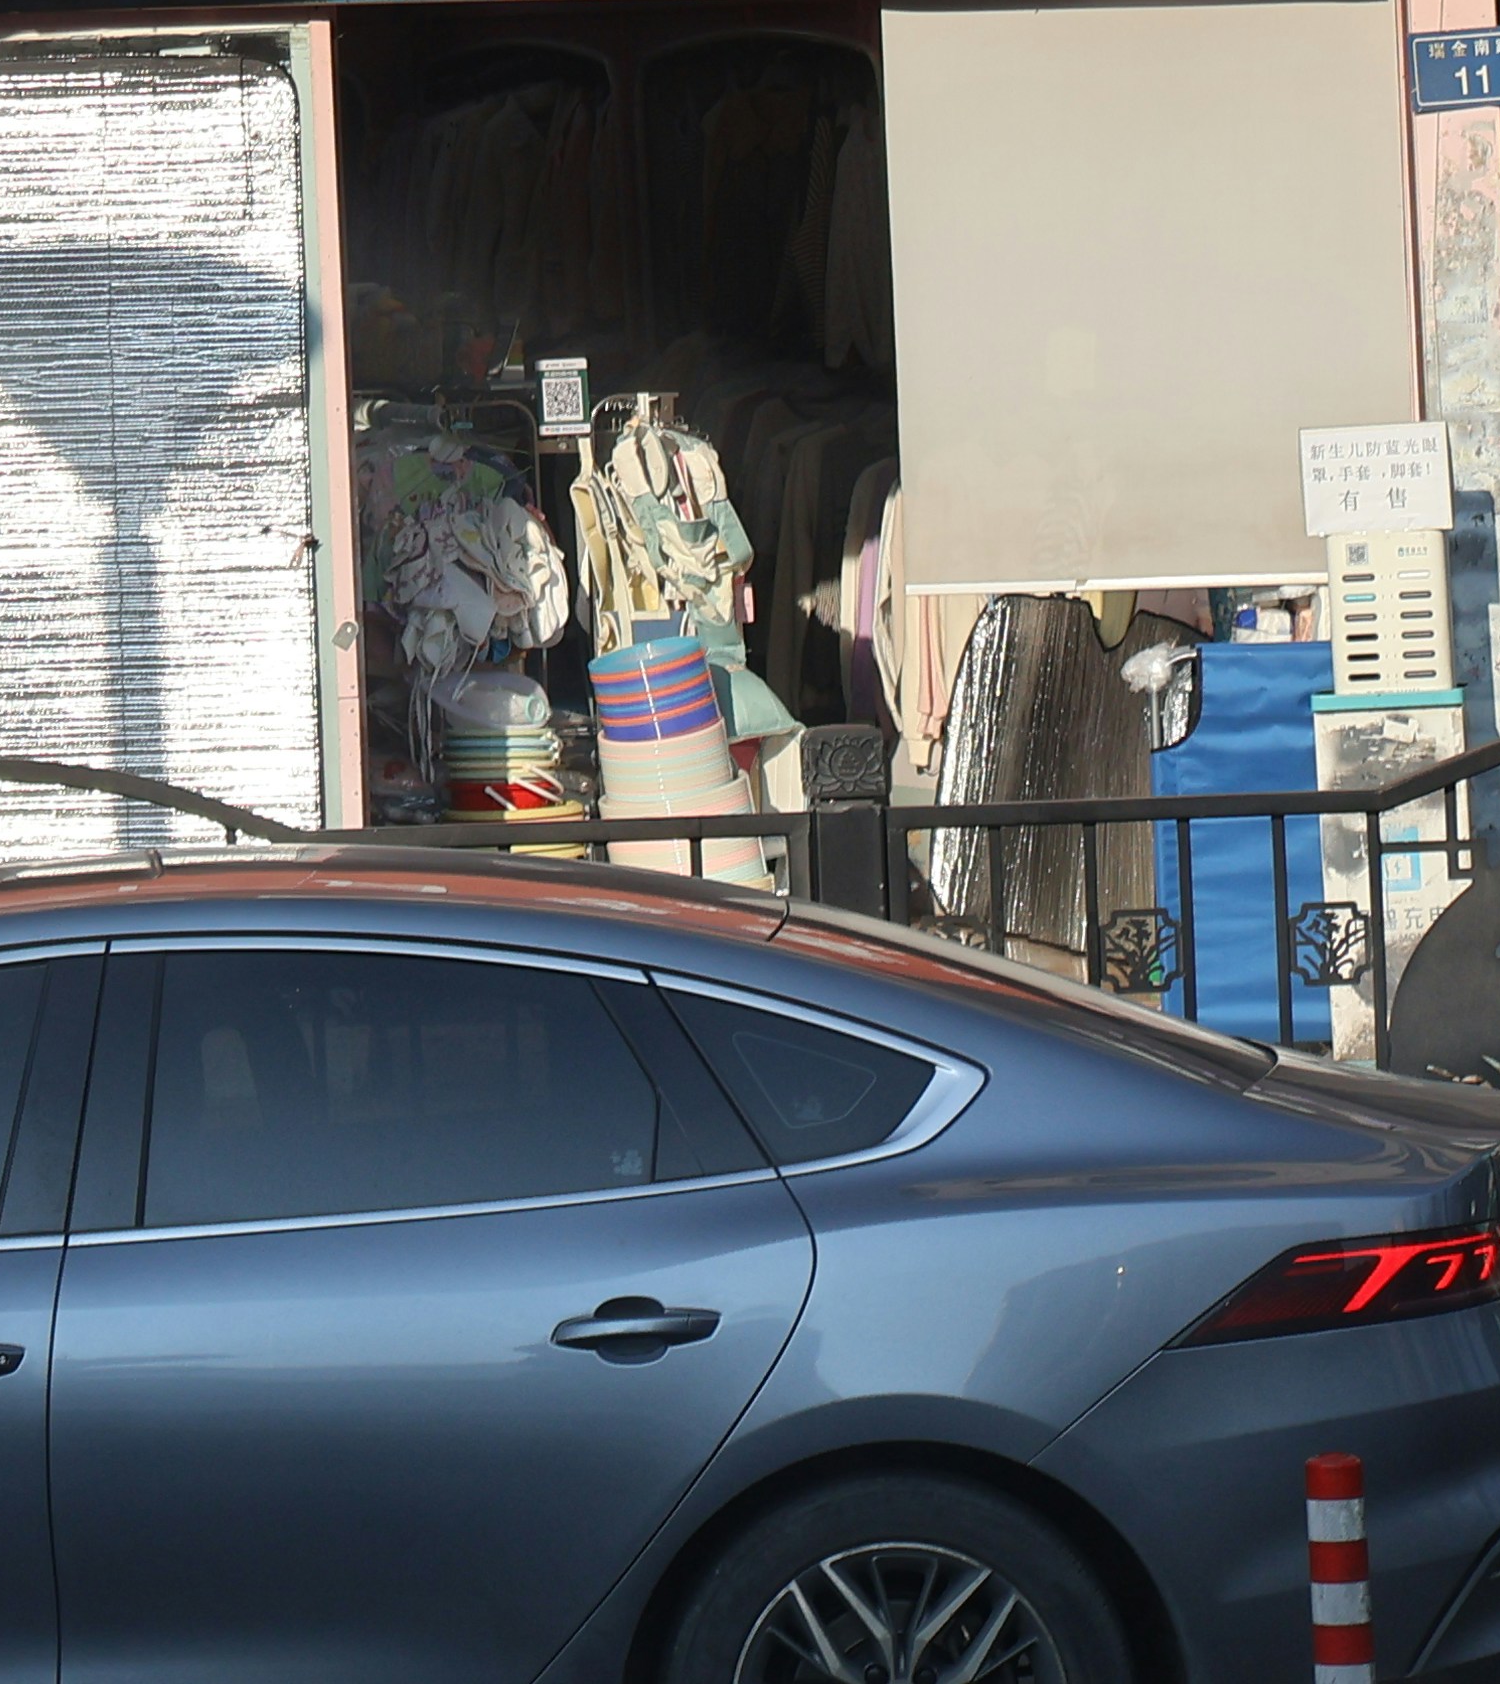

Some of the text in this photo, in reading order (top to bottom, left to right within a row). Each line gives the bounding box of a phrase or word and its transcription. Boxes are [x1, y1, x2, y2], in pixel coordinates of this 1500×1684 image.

[1454, 64, 1490, 96] 11
[1310, 437, 1438, 462] 新生儿防蓝光眼
